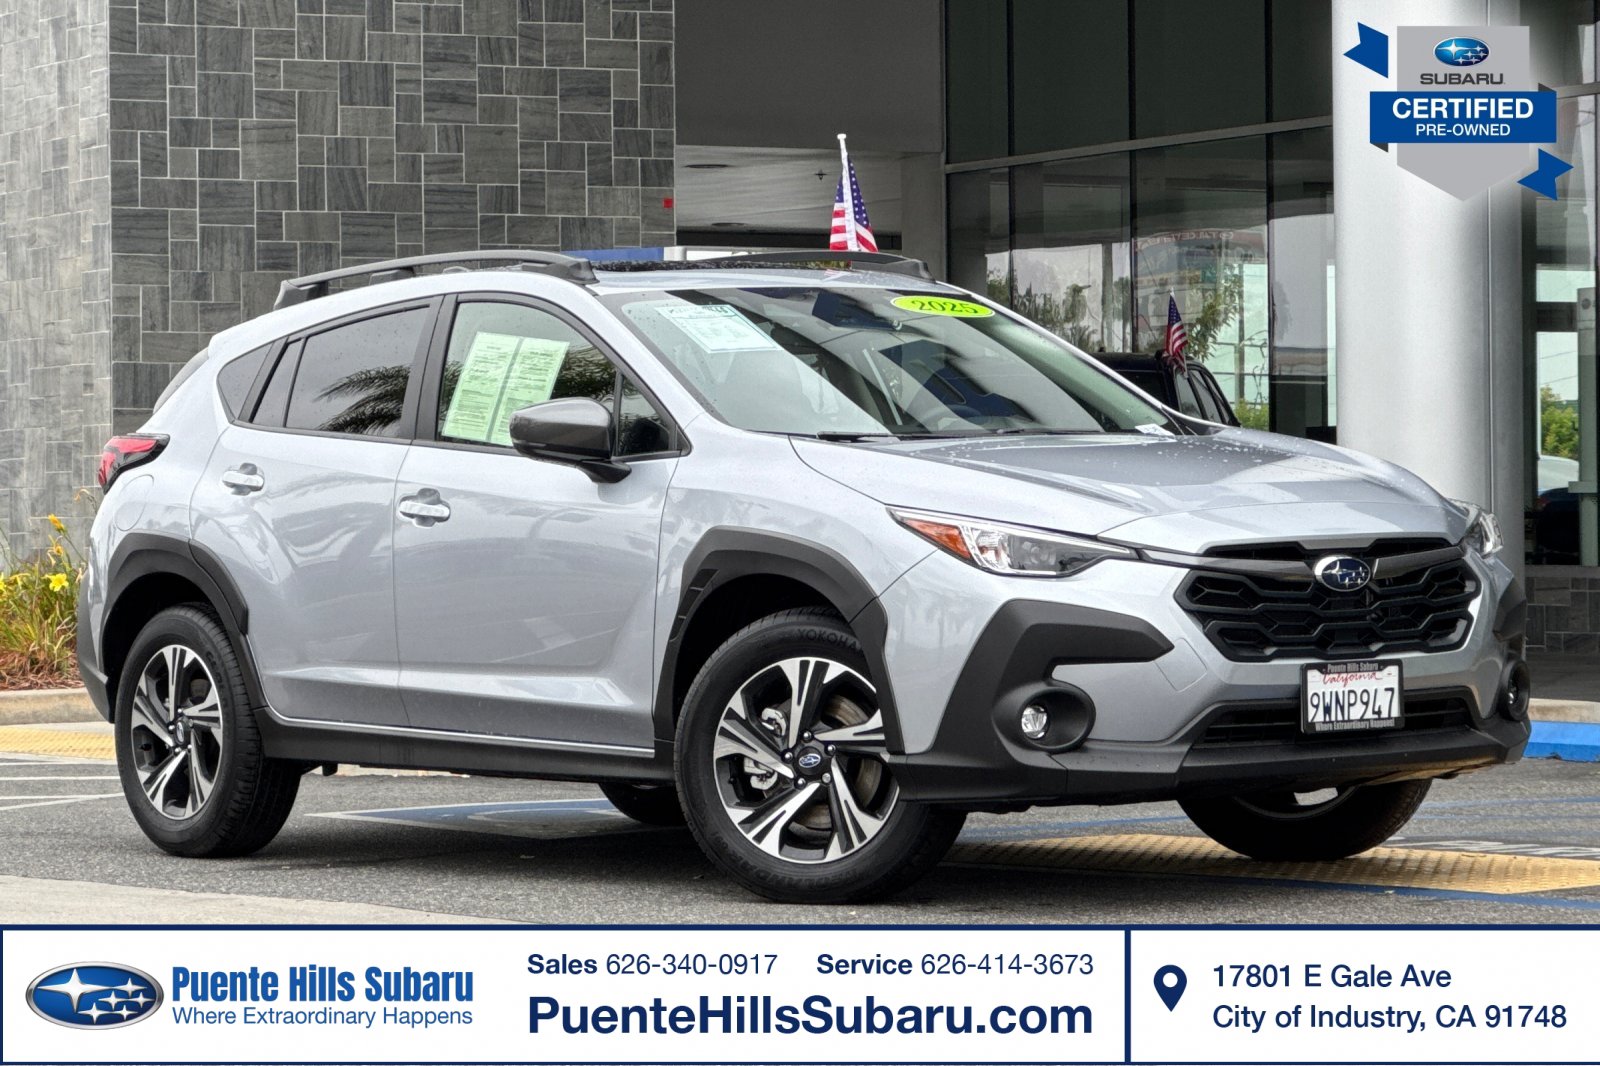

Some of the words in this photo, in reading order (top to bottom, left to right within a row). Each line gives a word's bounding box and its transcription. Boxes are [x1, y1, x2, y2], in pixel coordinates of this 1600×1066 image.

[911, 300, 979, 314] 2025
[1322, 671, 1383, 687] California
[1310, 687, 1395, 722] 9WNP947
